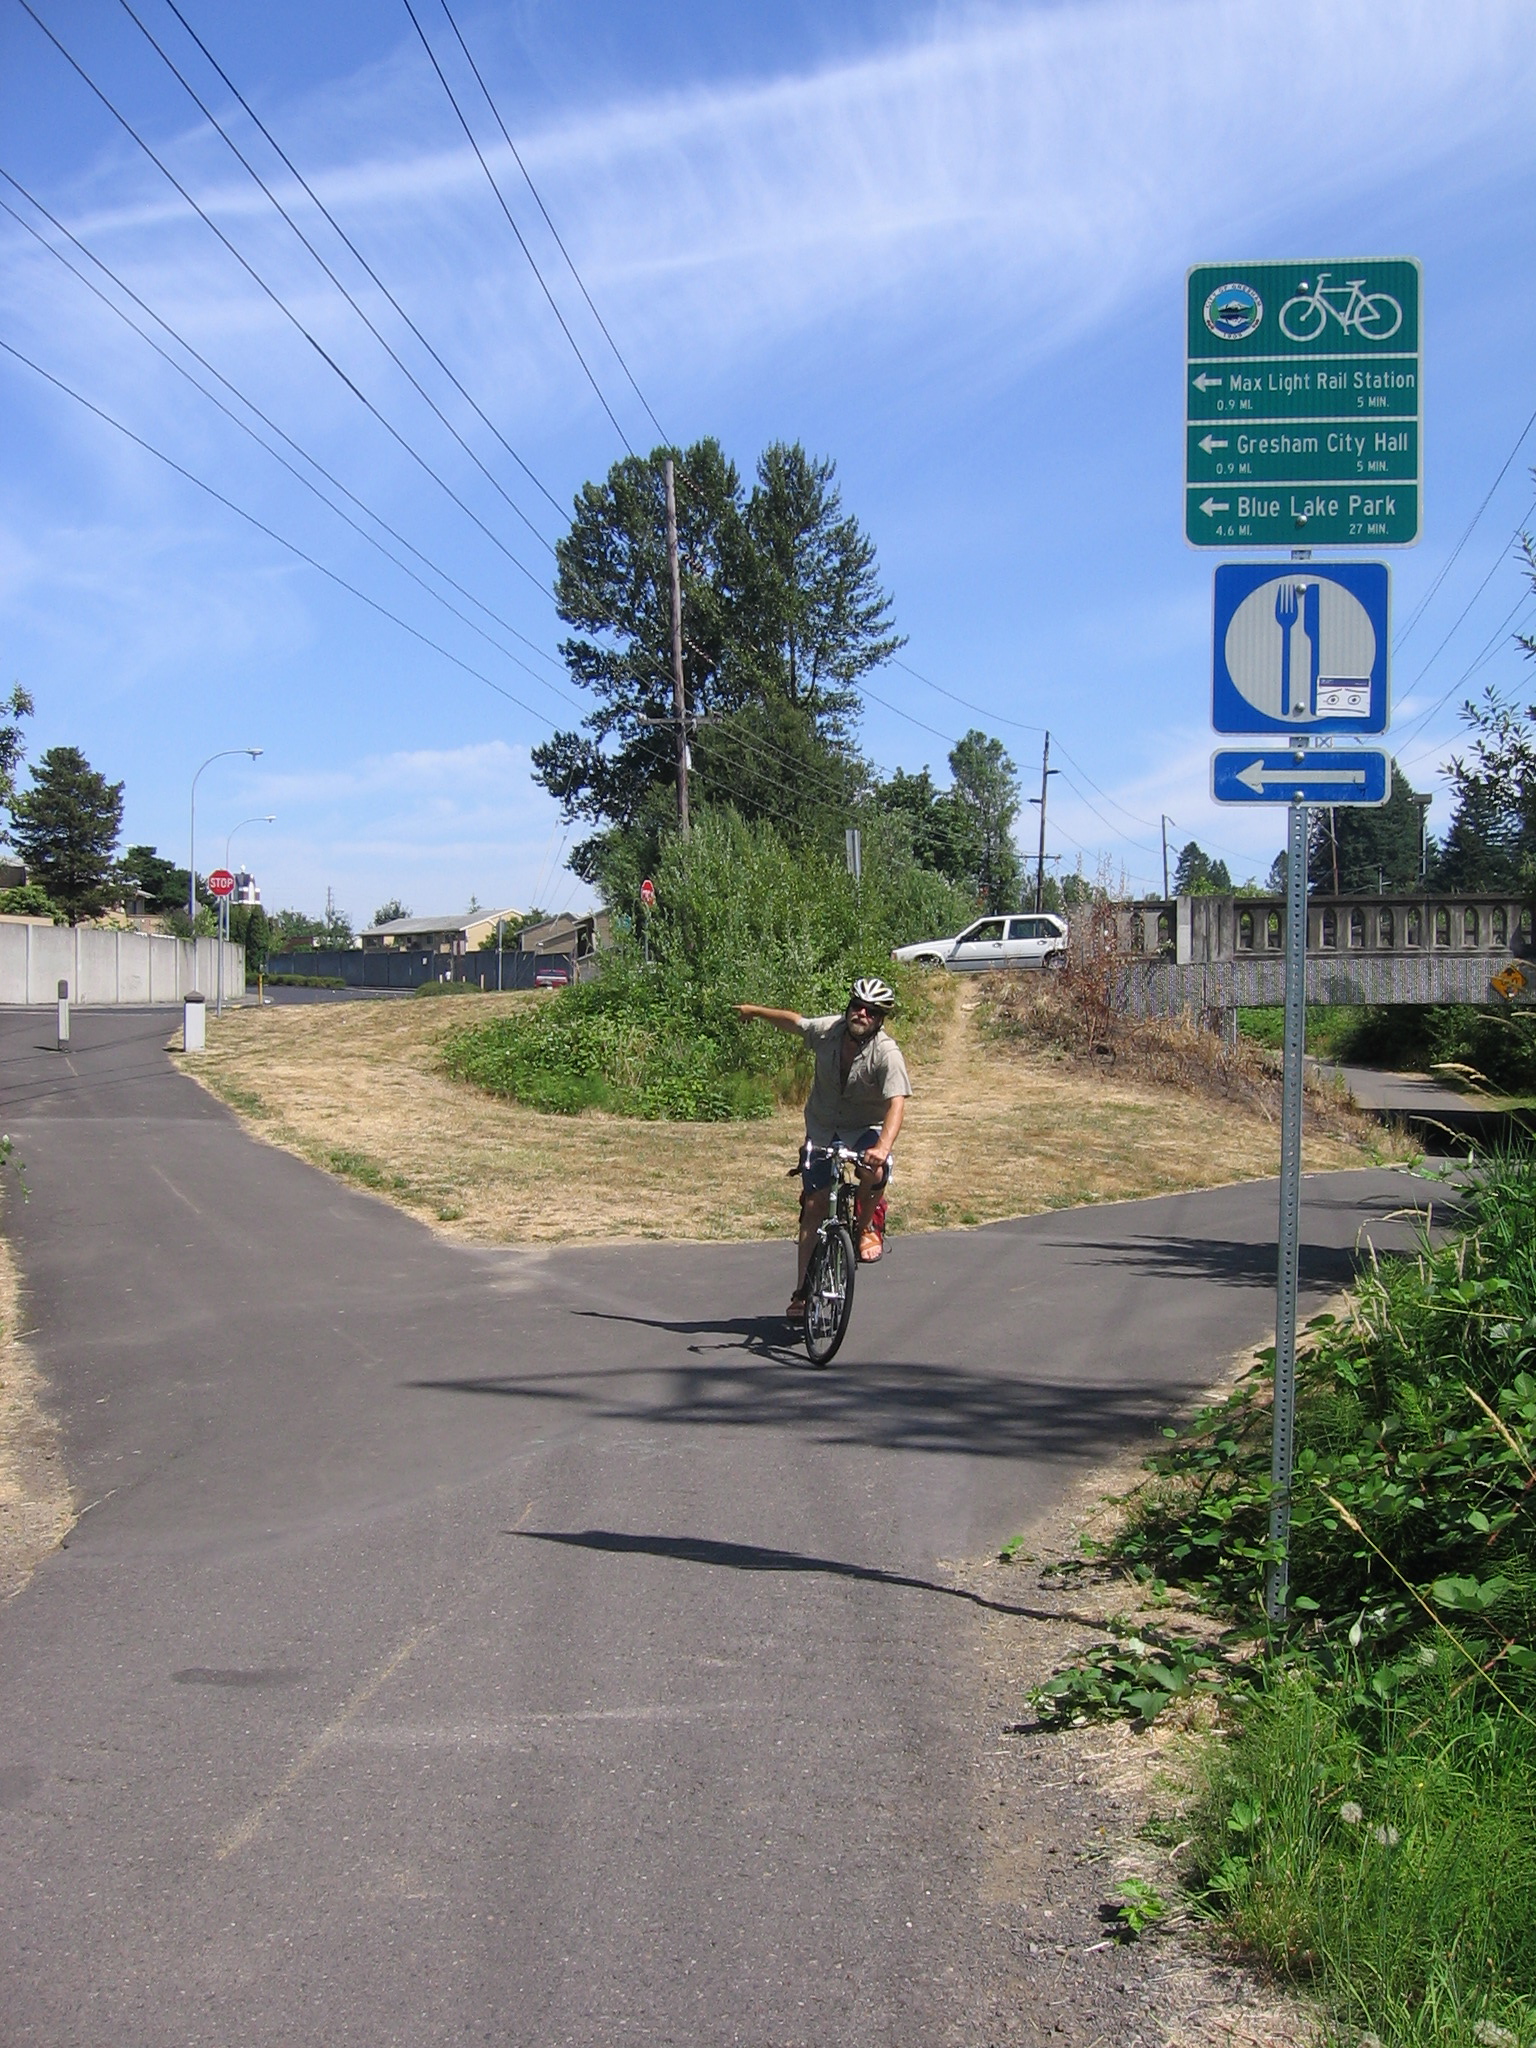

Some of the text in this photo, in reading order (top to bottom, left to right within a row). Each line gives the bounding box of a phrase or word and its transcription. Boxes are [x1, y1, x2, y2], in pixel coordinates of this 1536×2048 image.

[1230, 371, 1415, 396] Max Light Rail Station
[1216, 400, 1236, 411] 0.9
[1357, 396, 1390, 408] 5 MIN.
[1237, 432, 1408, 457] Gresham City Hall
[1216, 463, 1235, 475] 0.9
[1357, 461, 1389, 472] 5 MIN.
[1237, 494, 1396, 518] Blue Lake Park
[1215, 525, 1235, 537] 4.6
[1349, 524, 1389, 535] 27 MIN.
[210, 877, 234, 889] STOP
